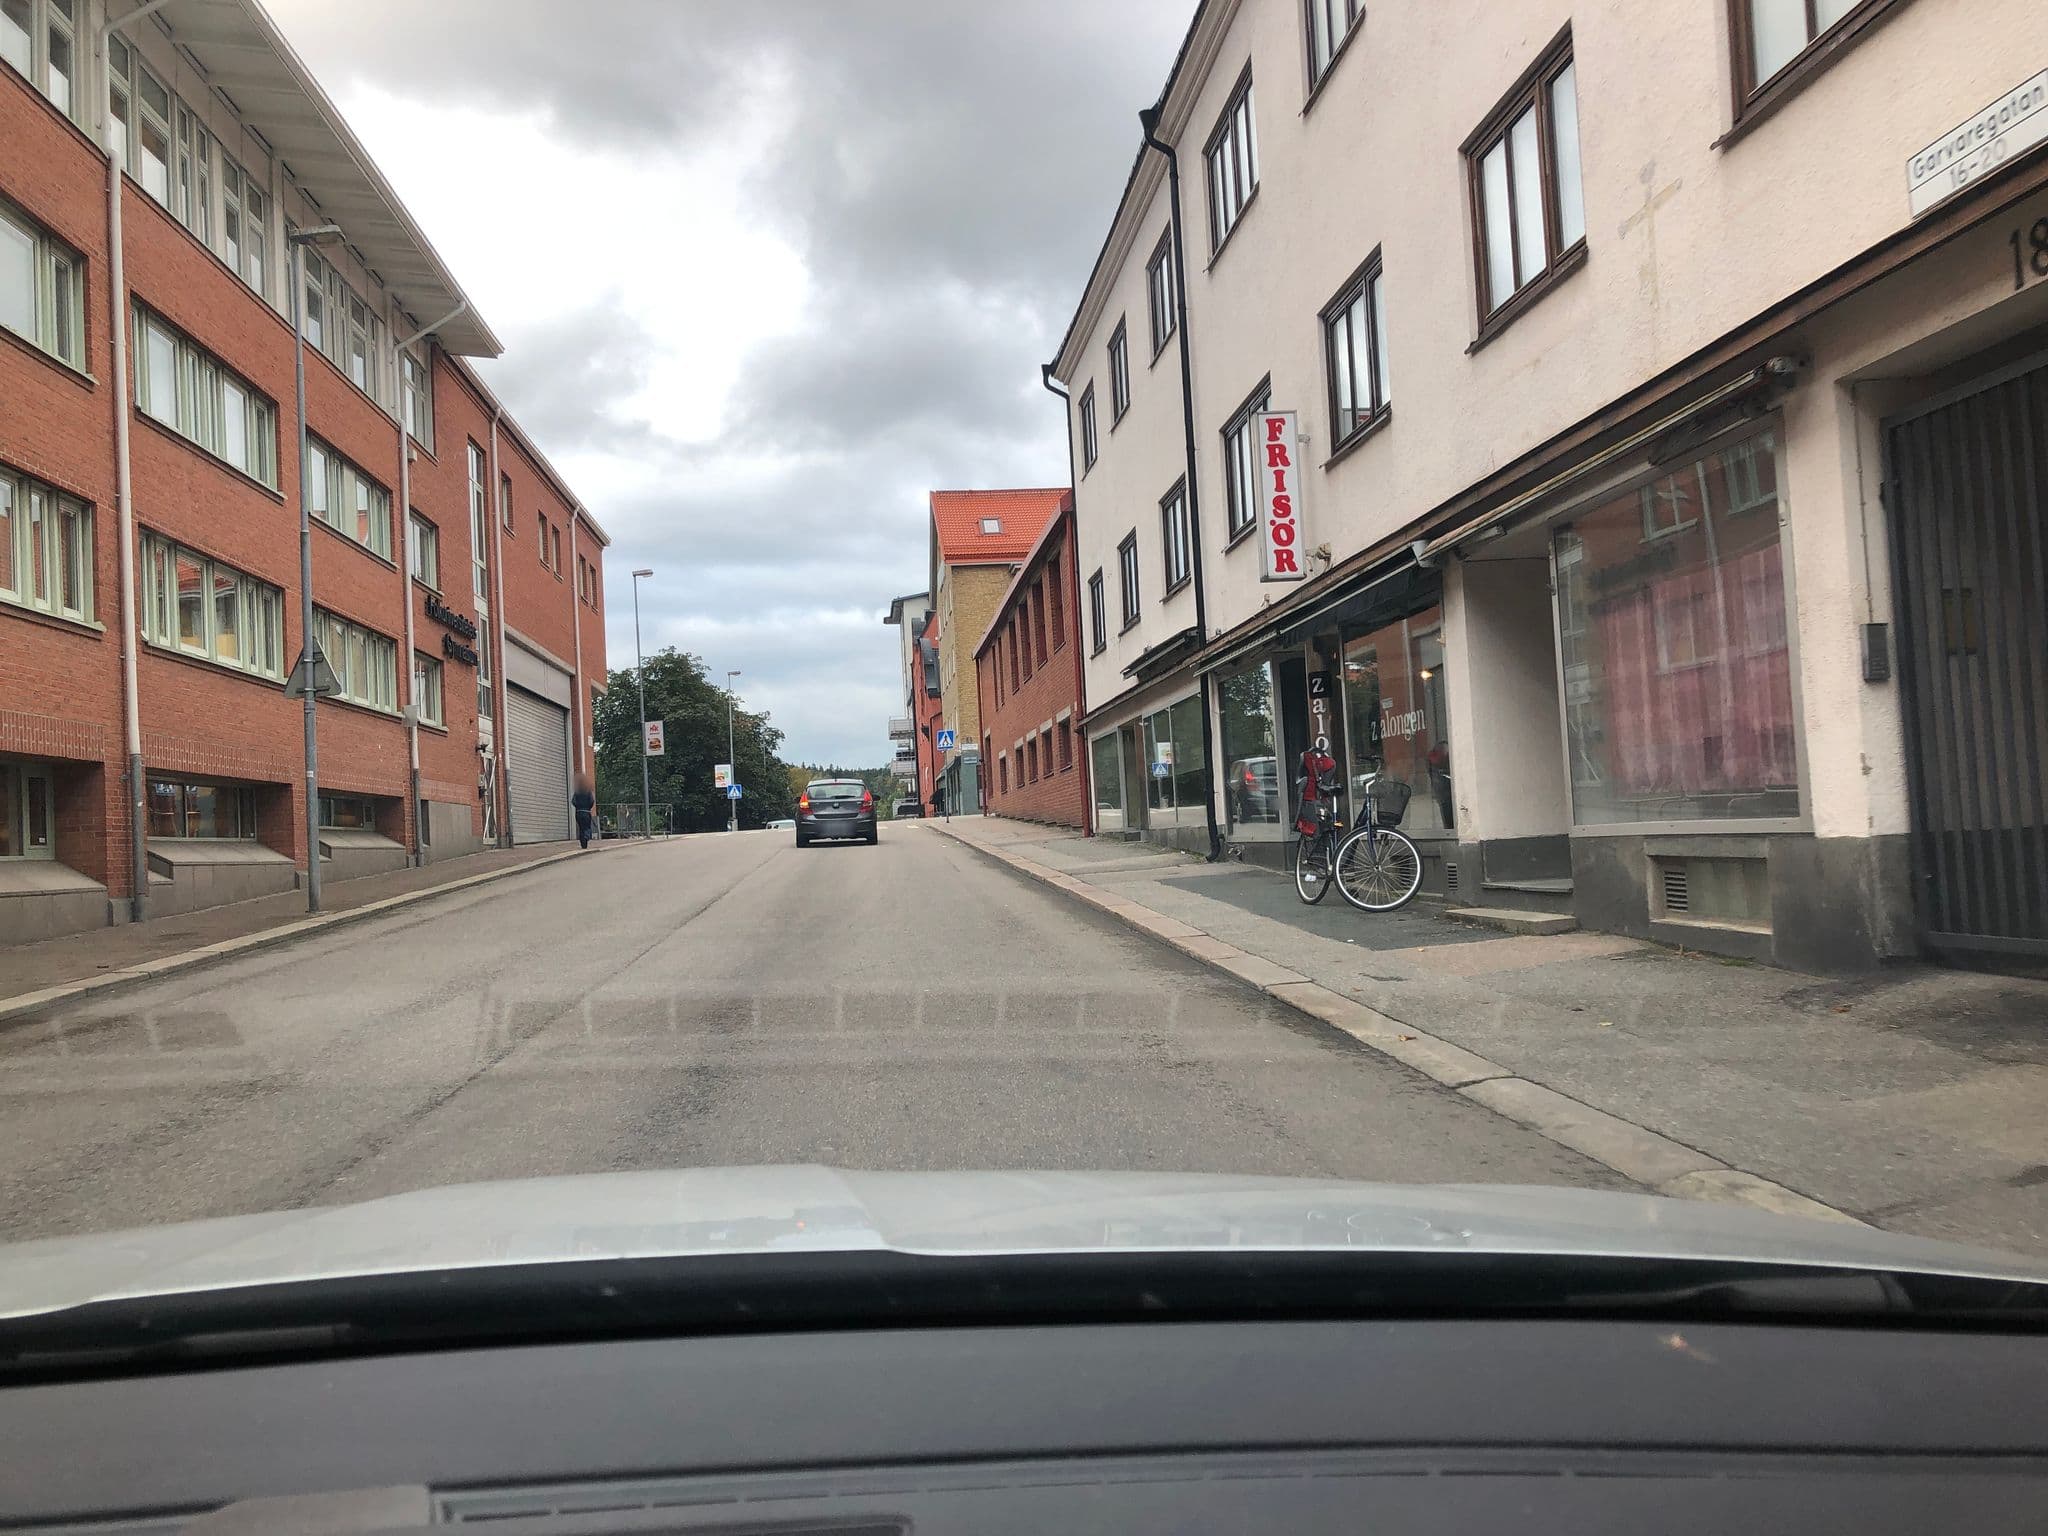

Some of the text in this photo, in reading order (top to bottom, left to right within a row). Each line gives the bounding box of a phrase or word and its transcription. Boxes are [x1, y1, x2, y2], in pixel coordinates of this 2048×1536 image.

[1913, 85, 2046, 180] Garvaregatan
[1949, 138, 2008, 189] 16-20
[2010, 217, 2048, 291] 18
[1266, 418, 1298, 573] FRISÖR
